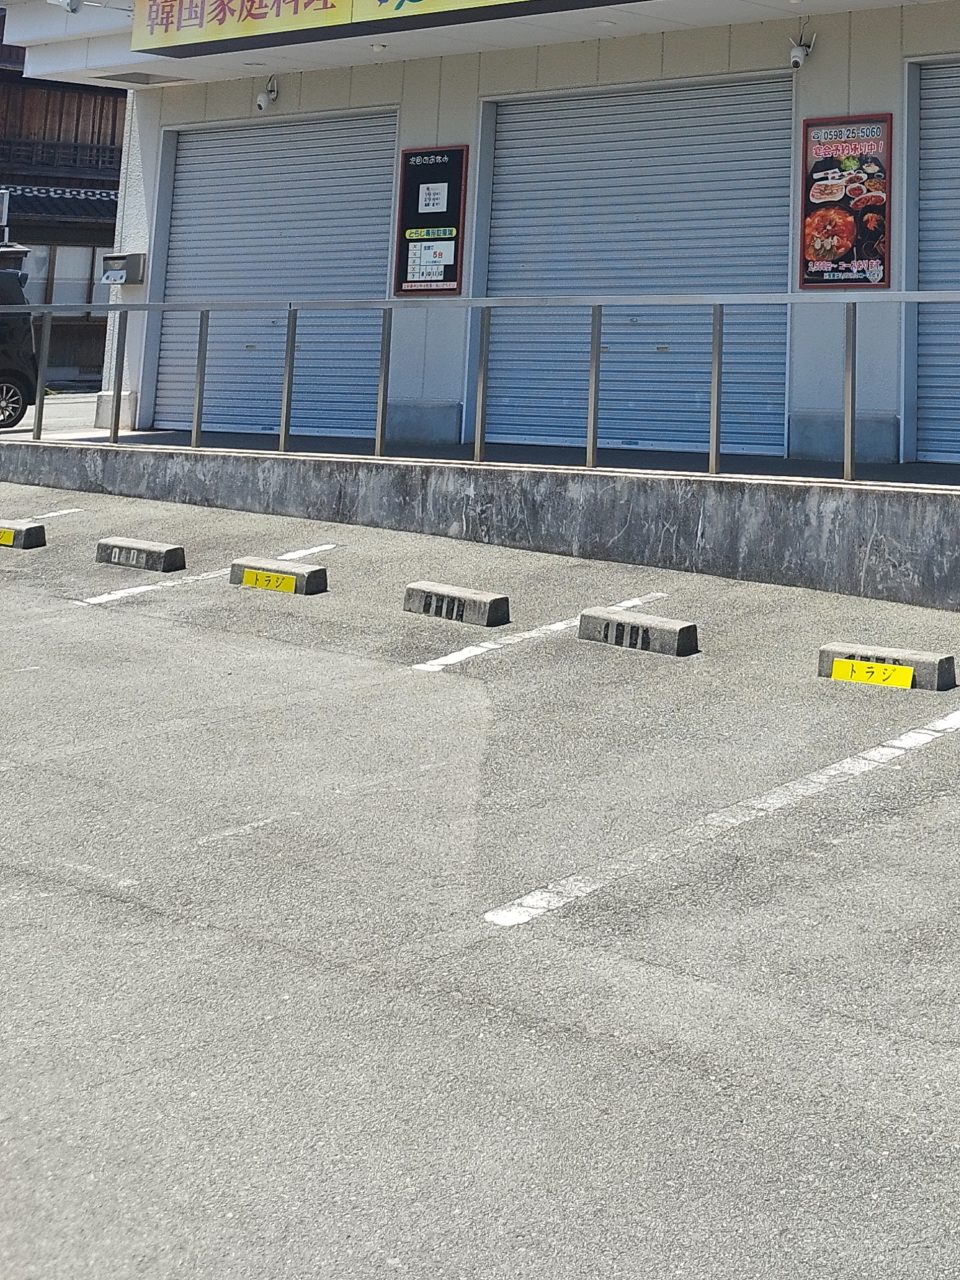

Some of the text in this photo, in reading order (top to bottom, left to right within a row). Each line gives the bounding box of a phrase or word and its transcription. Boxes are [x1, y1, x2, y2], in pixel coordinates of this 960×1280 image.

[255, 572, 286, 588] トラジ
[849, 663, 896, 682] トラジ
